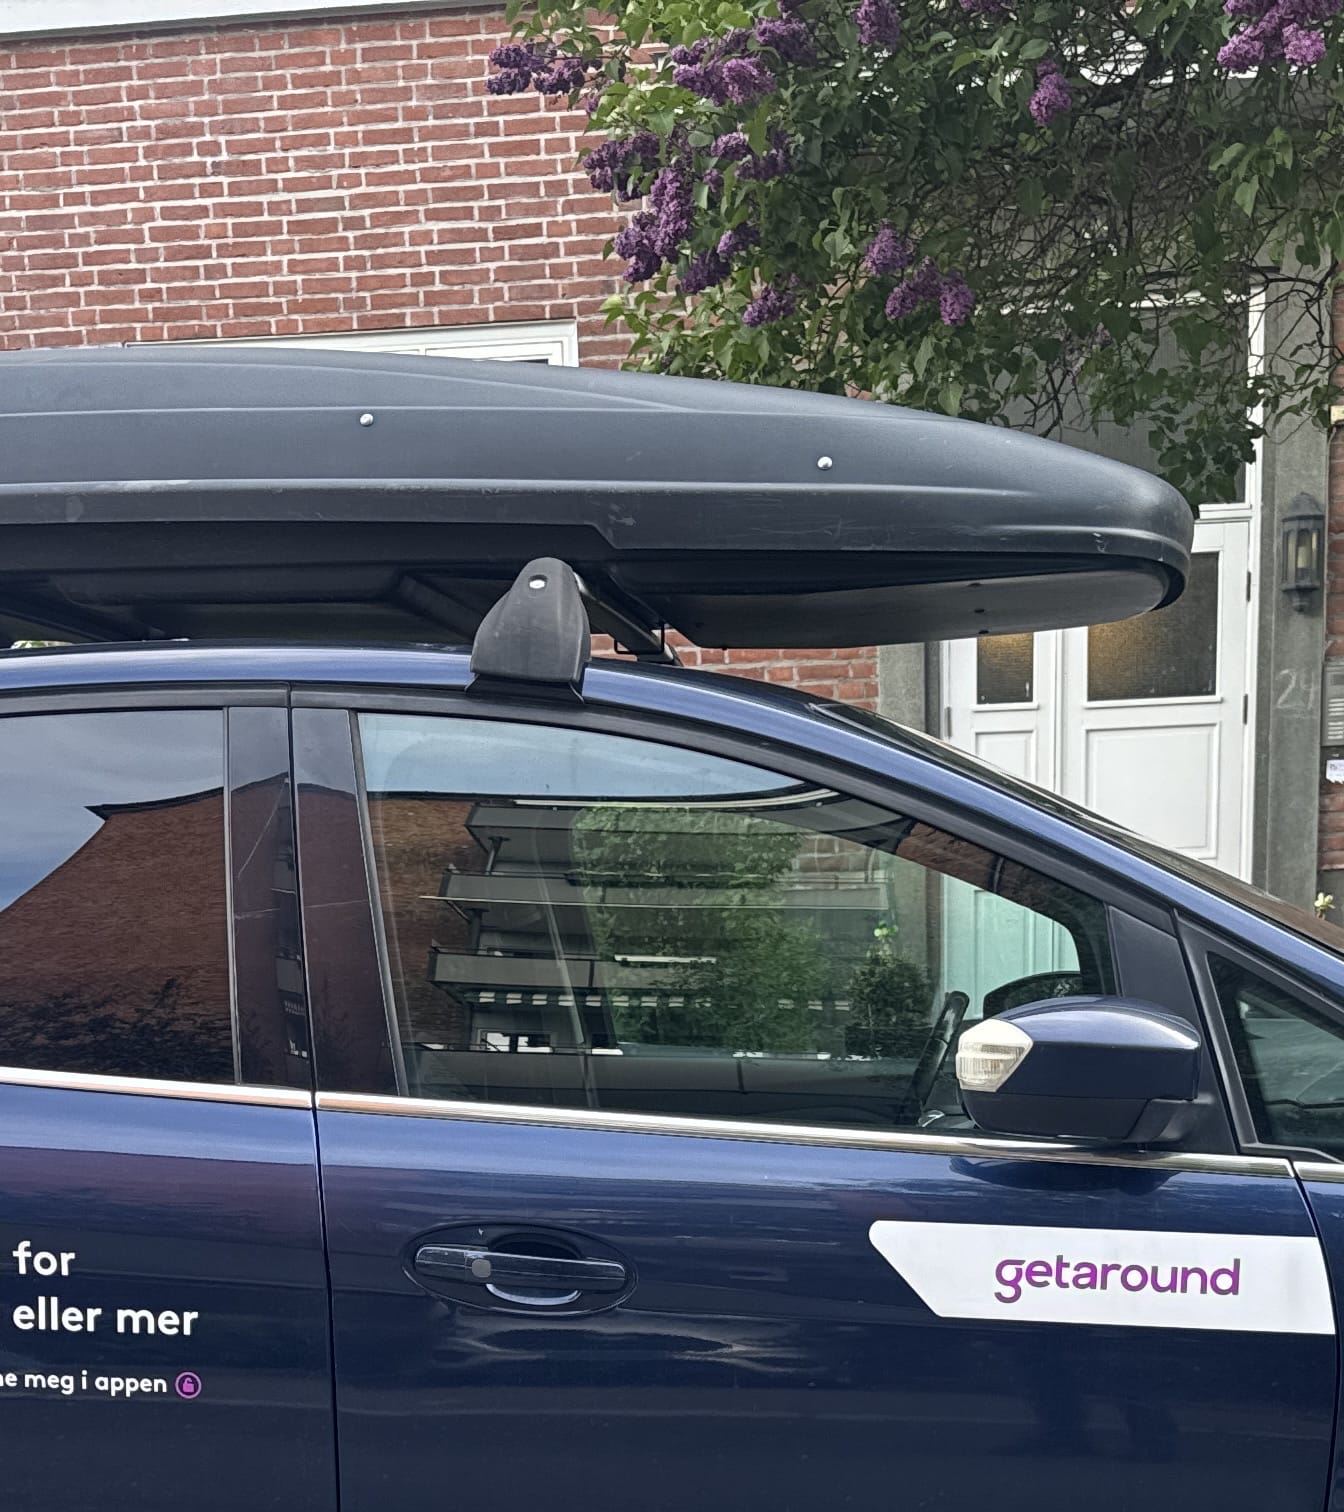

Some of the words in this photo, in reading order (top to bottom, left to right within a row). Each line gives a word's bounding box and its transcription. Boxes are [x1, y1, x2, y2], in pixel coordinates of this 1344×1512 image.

[12, 1240, 76, 1276] for
[994, 1254, 1241, 1304] getaround
[12, 1295, 102, 1333] eller
[116, 1307, 199, 1336] mer
[24, 1371, 75, 1395] meg
[81, 1369, 88, 1391] i
[94, 1375, 167, 1397] appen
